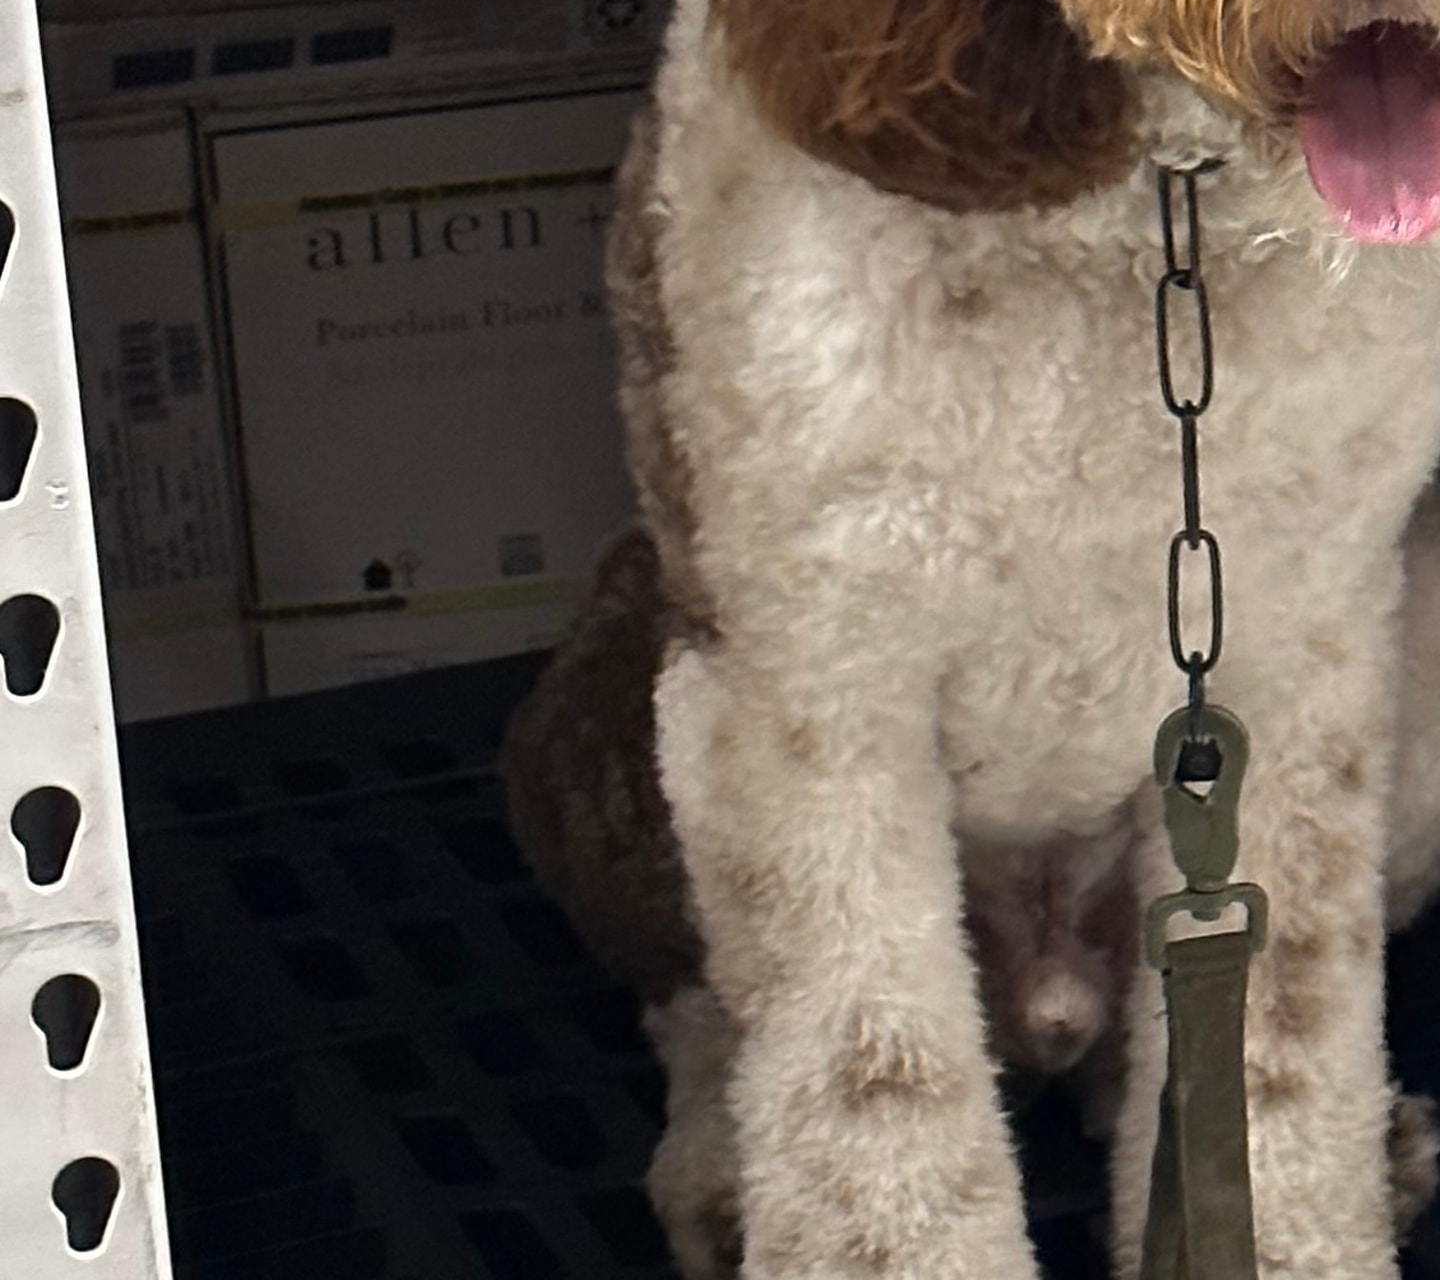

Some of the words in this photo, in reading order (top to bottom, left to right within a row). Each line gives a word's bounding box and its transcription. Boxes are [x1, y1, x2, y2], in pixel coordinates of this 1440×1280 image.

[305, 205, 543, 272] allen
[314, 309, 469, 346] Porcelain
[482, 300, 566, 328] Floor
